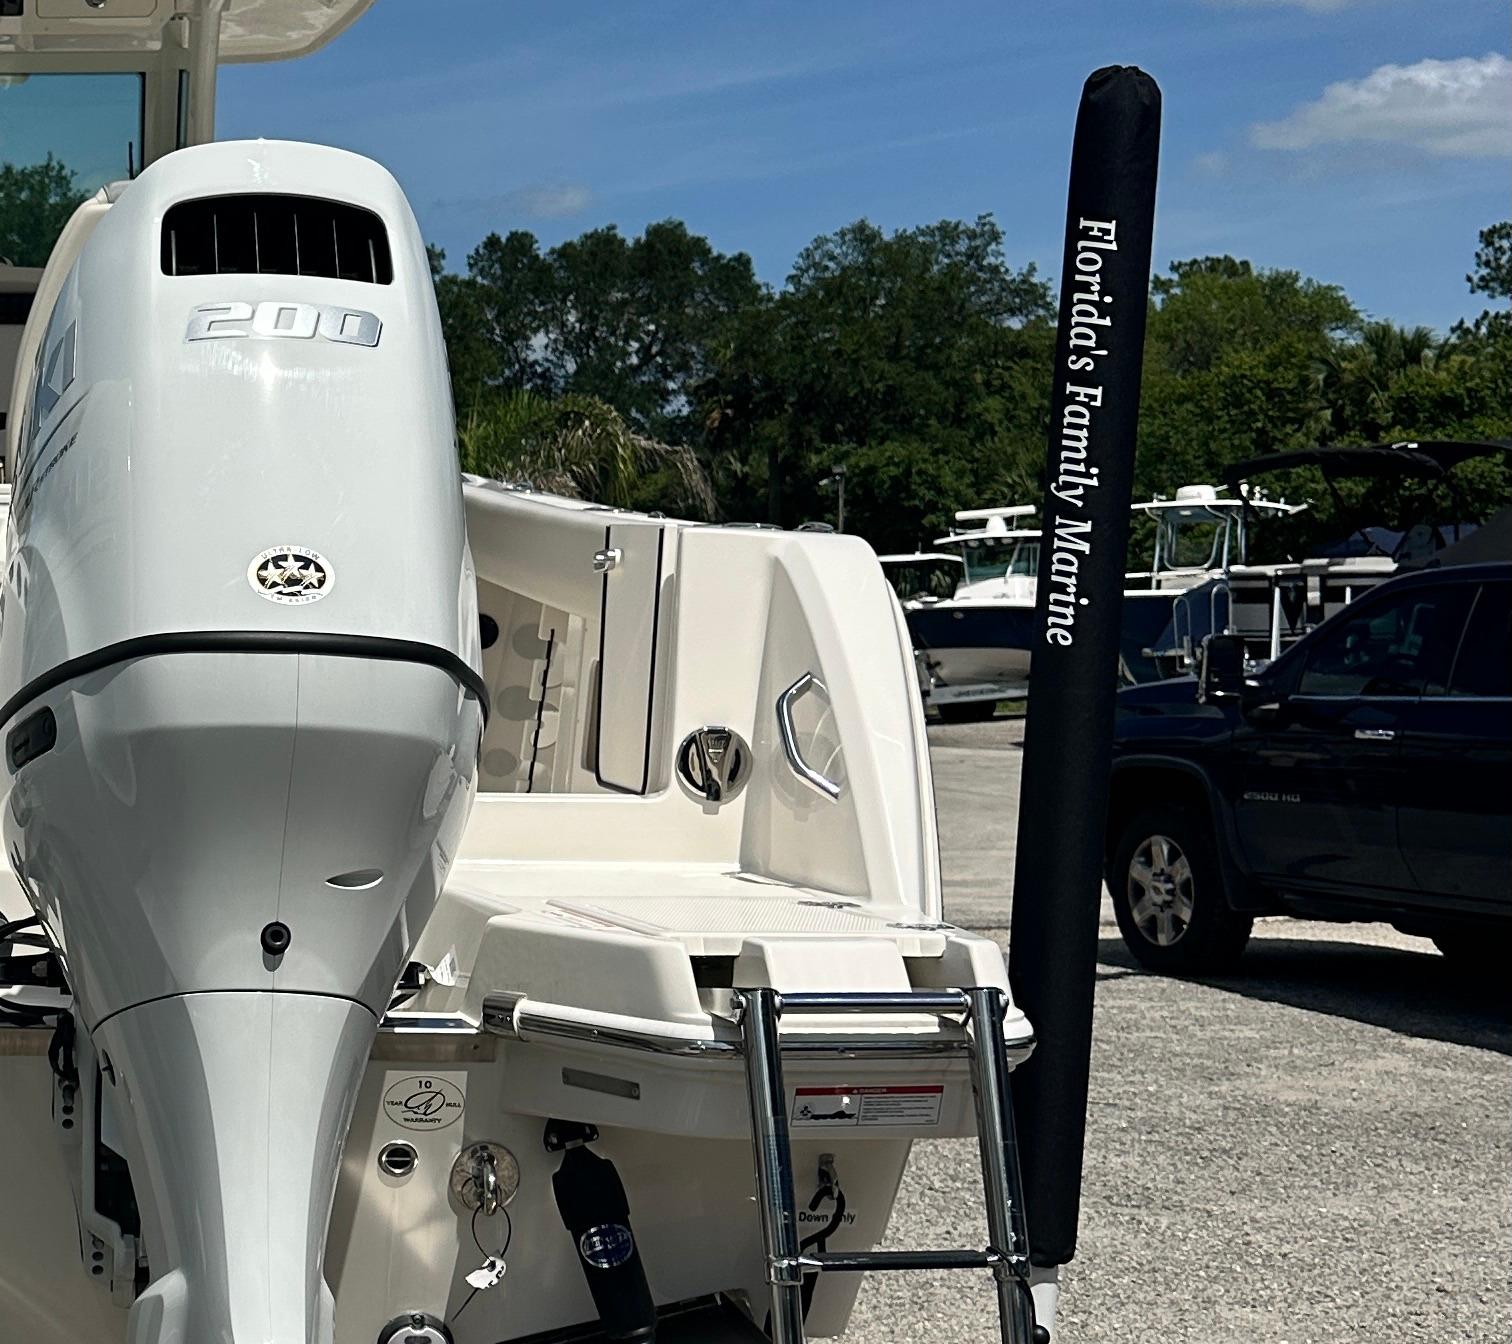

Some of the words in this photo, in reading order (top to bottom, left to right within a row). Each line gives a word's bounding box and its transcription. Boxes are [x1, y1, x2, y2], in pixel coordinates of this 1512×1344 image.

[184, 301, 383, 347] 200
[1067, 217, 1118, 372] Florida's
[1050, 382, 1103, 507] Family
[1046, 515, 1092, 646] Marine
[418, 1080, 433, 1089] 10
[799, 1211, 829, 1223] Down
